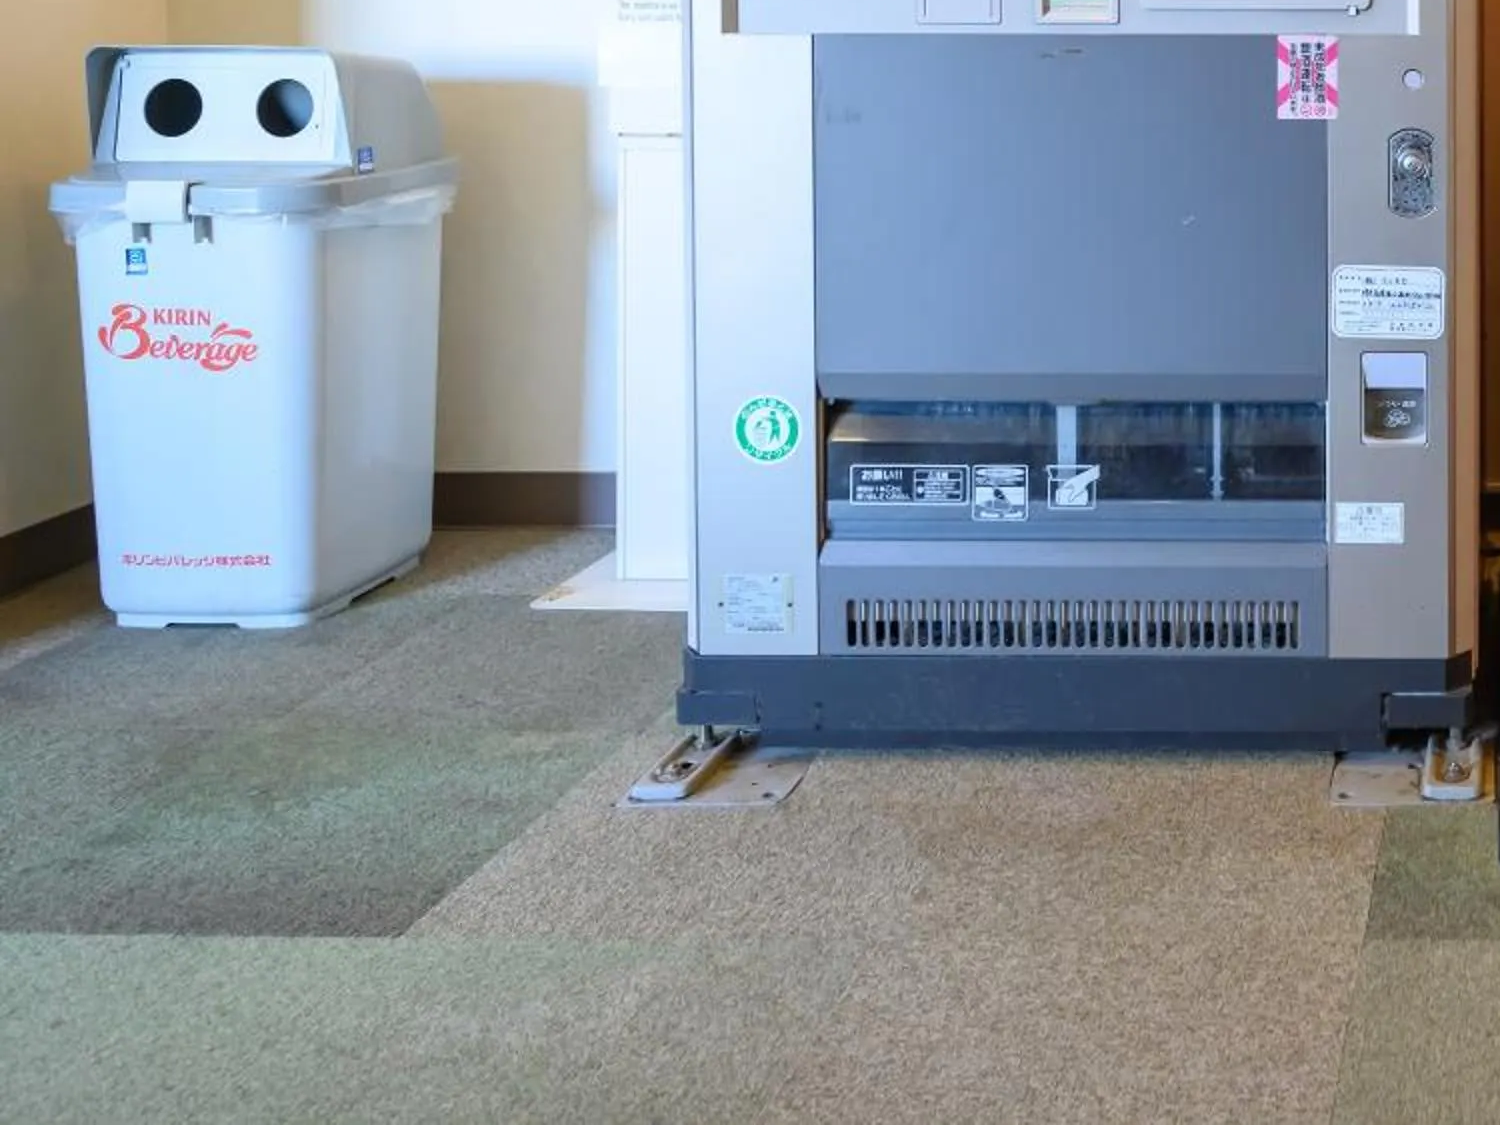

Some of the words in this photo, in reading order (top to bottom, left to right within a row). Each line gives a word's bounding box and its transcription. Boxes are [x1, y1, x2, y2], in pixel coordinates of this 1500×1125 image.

[153, 308, 212, 326] KIRIN
[98, 302, 259, 372] Beverage
[121, 553, 272, 568] キリンビバレッジ株式会社
